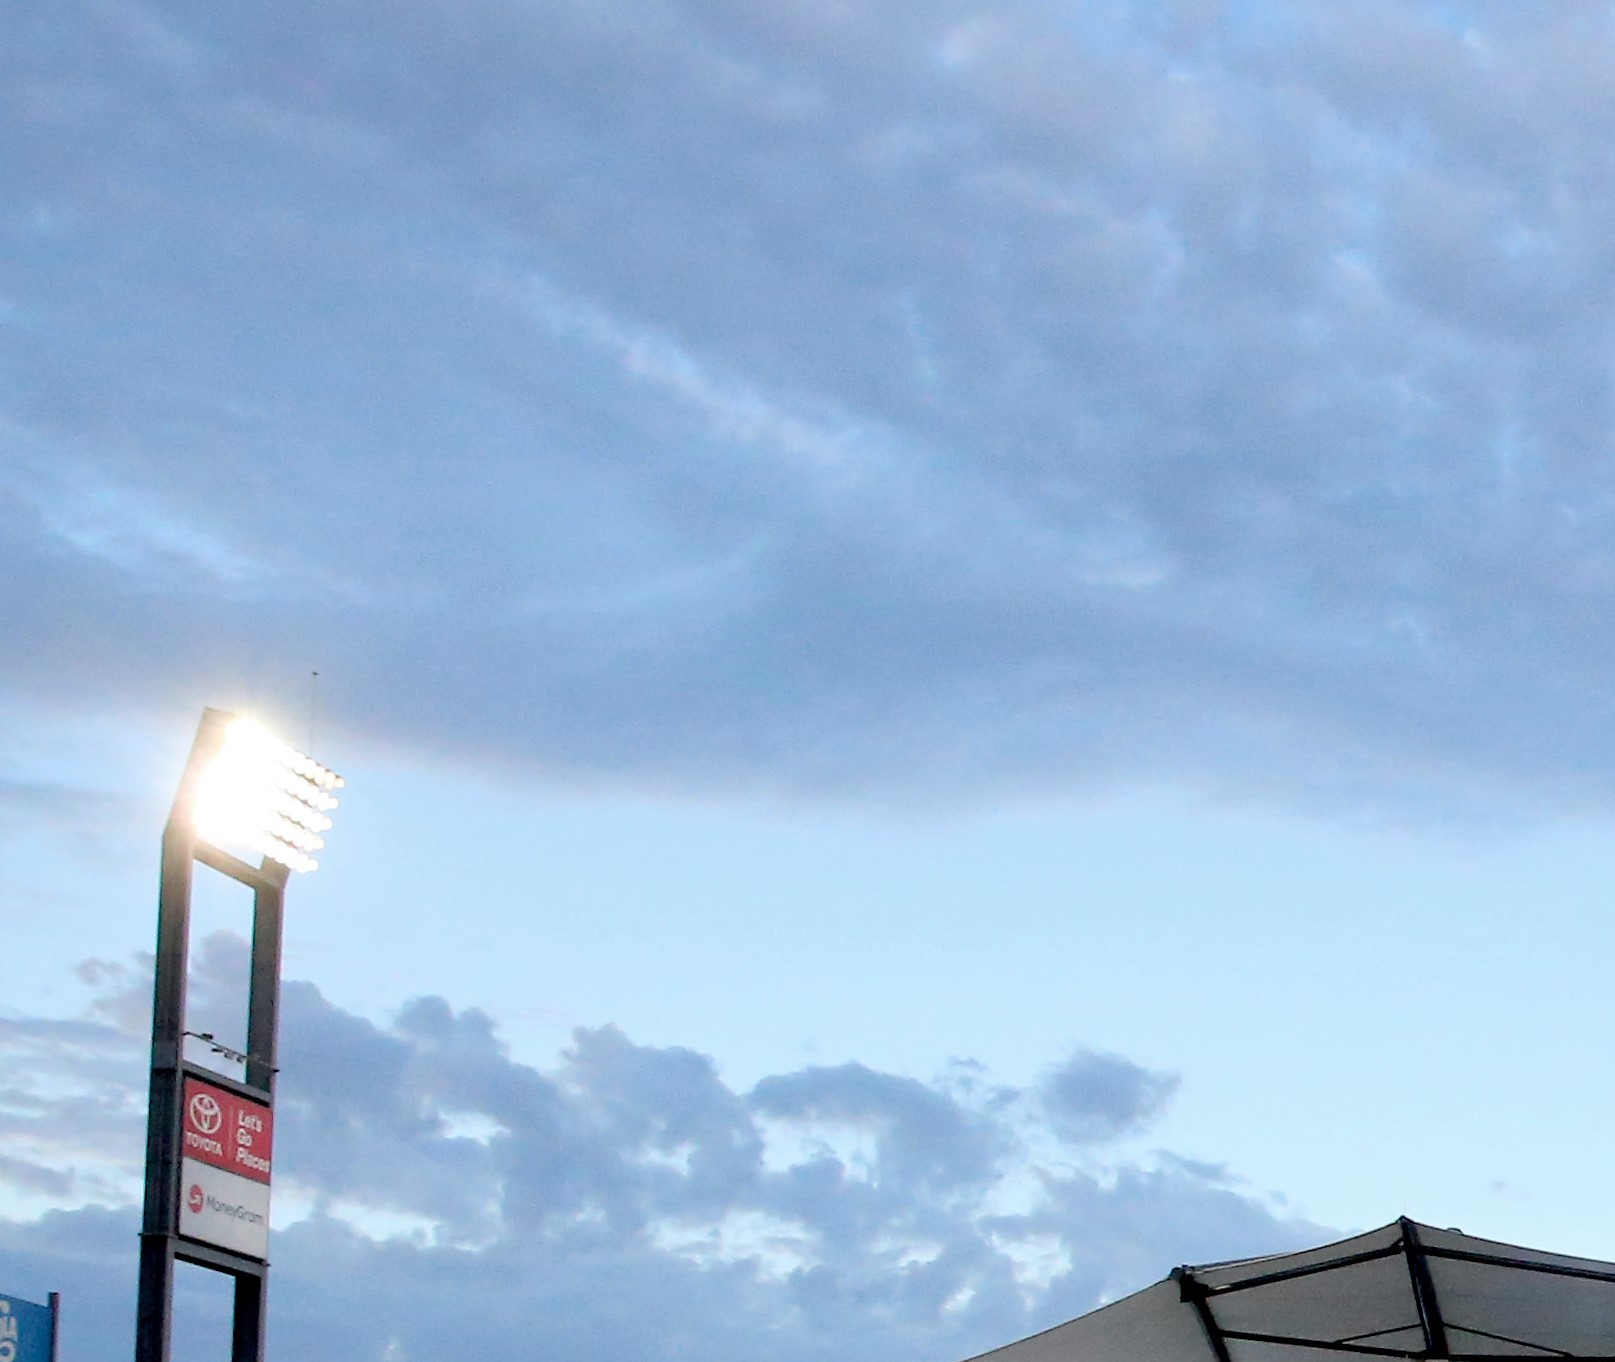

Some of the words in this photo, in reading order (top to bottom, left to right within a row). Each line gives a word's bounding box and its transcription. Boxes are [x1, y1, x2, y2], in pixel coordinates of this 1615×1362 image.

[186, 1130, 223, 1156] TOYOTA
[236, 1128, 253, 1147] Go
[206, 1196, 265, 1226] MoneyGram
